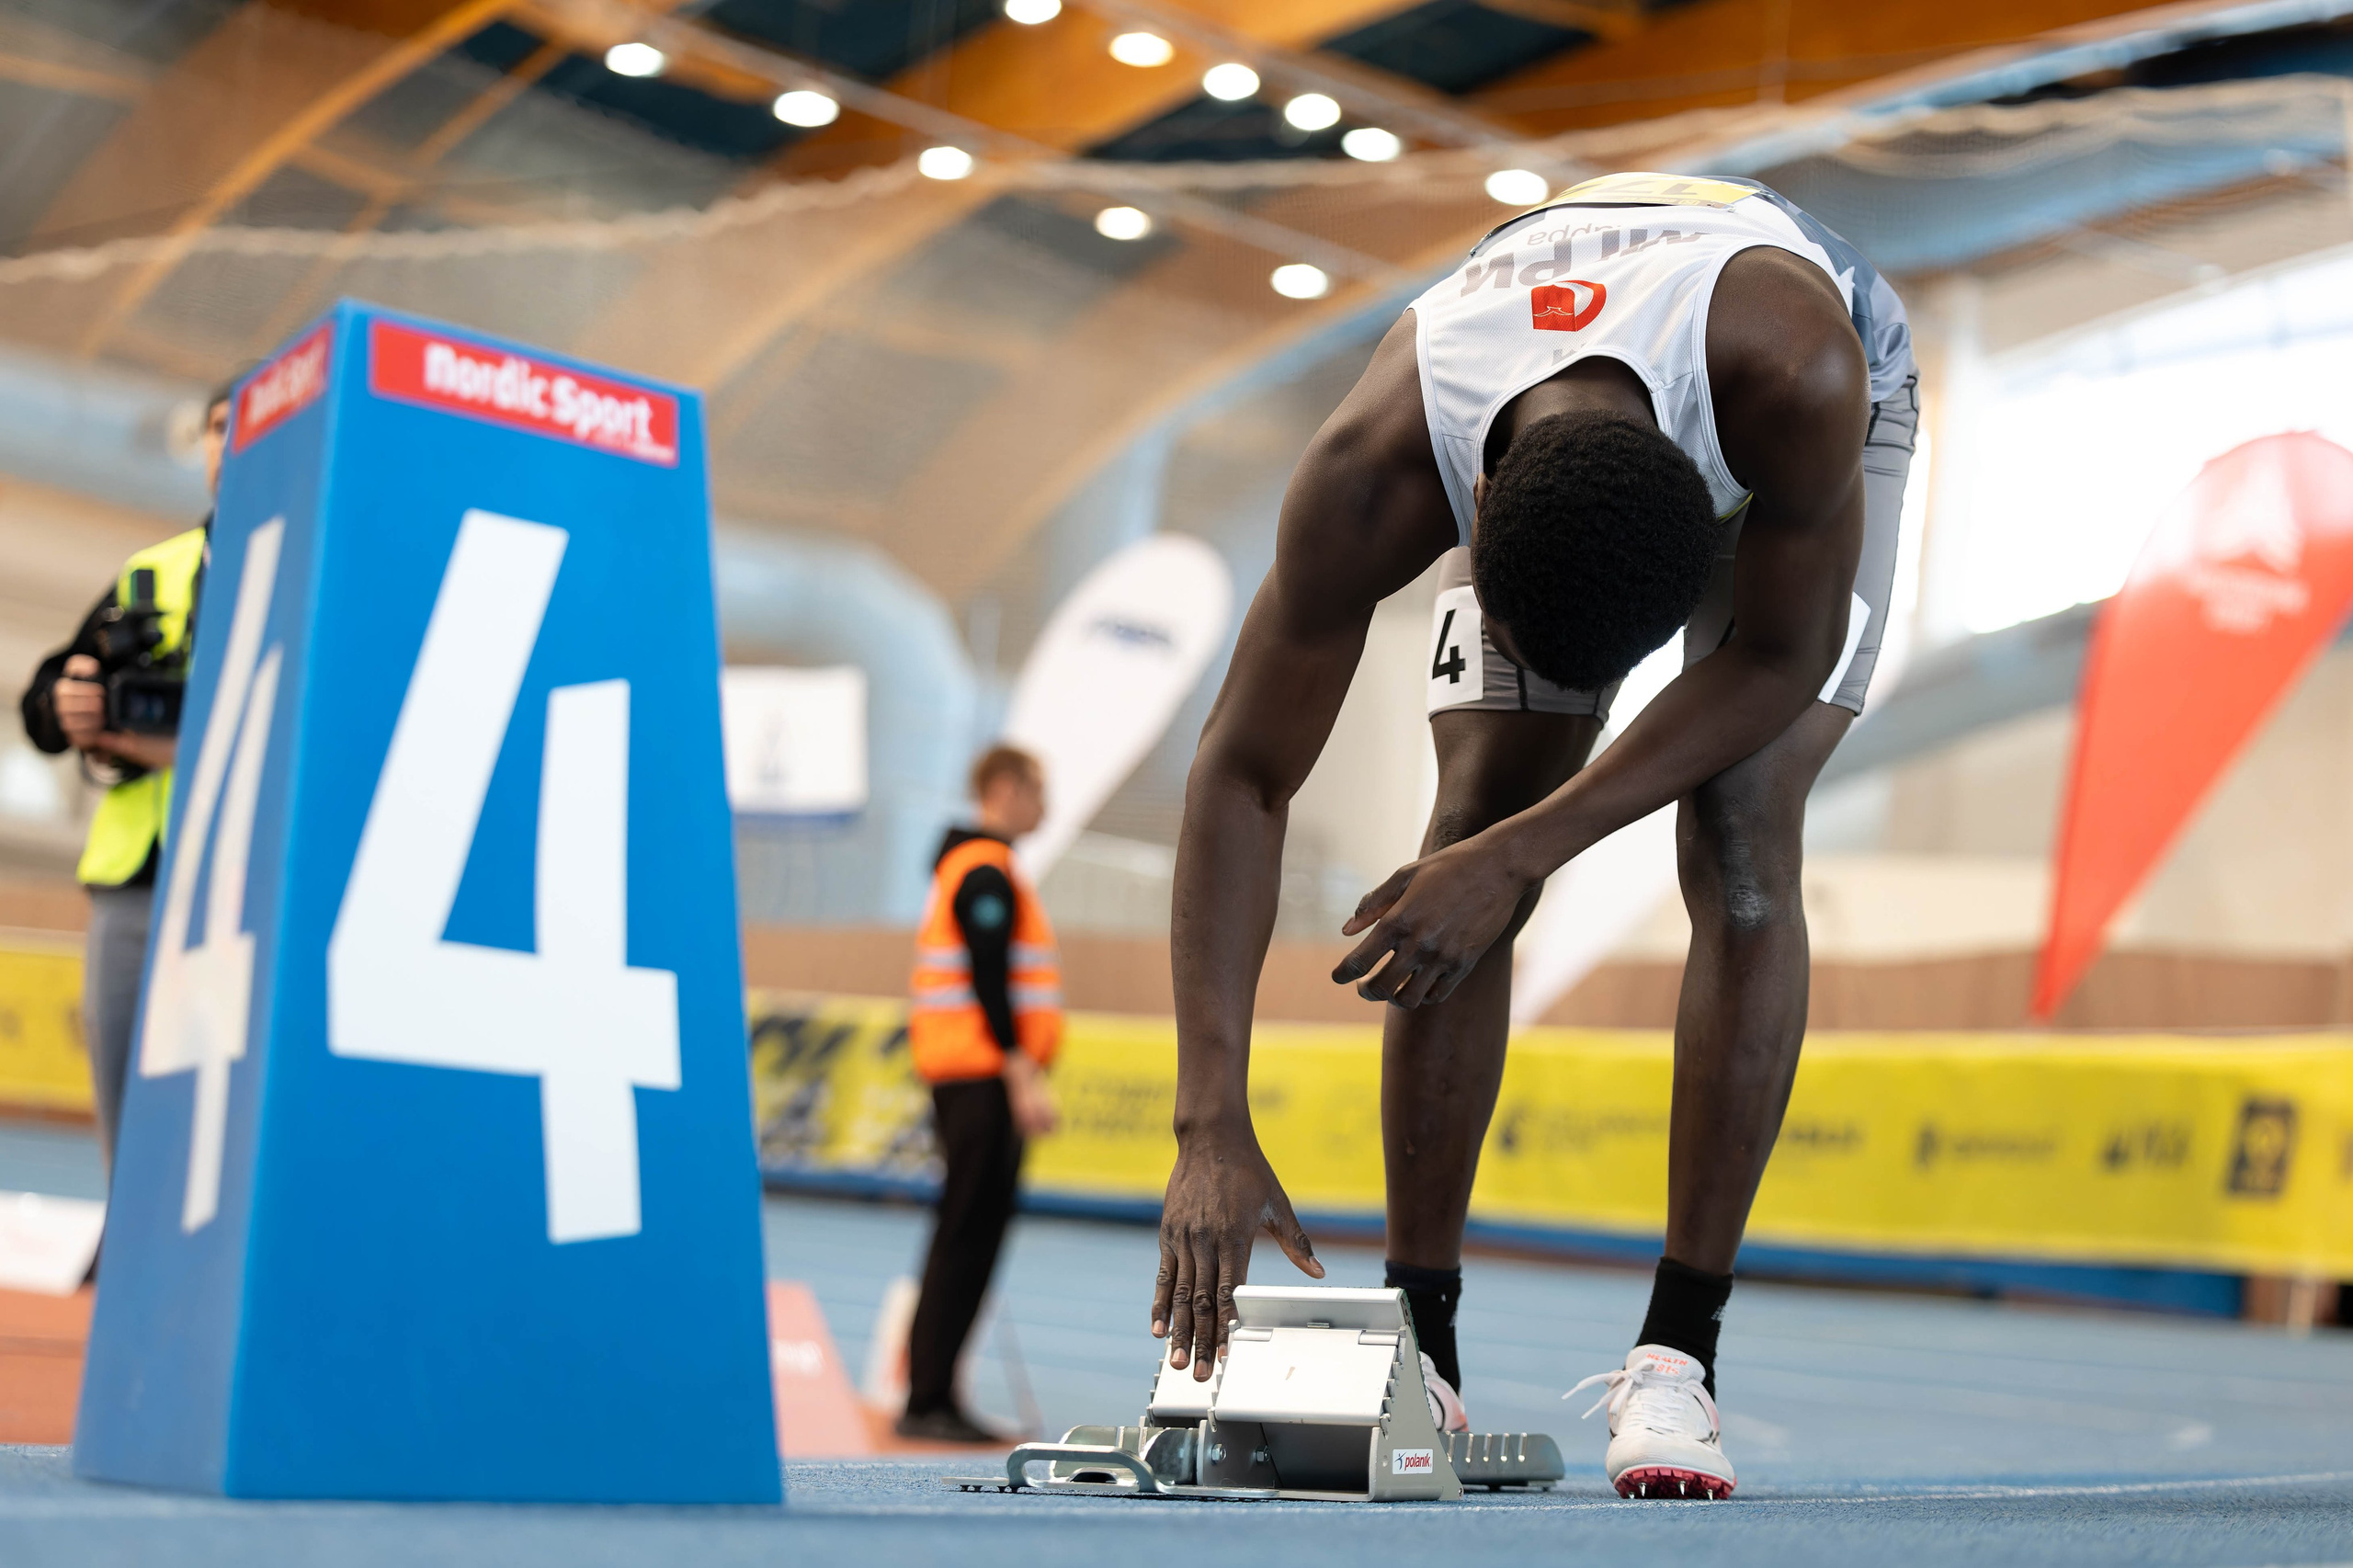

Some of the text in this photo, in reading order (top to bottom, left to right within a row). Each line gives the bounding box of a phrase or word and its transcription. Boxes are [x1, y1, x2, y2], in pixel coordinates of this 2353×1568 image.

[551, 377, 653, 441] Sport
[1432, 608, 1466, 684] 4
[140, 516, 285, 1233] 4
[326, 507, 682, 1244] 4
[1404, 1453, 1431, 1471] polanik
